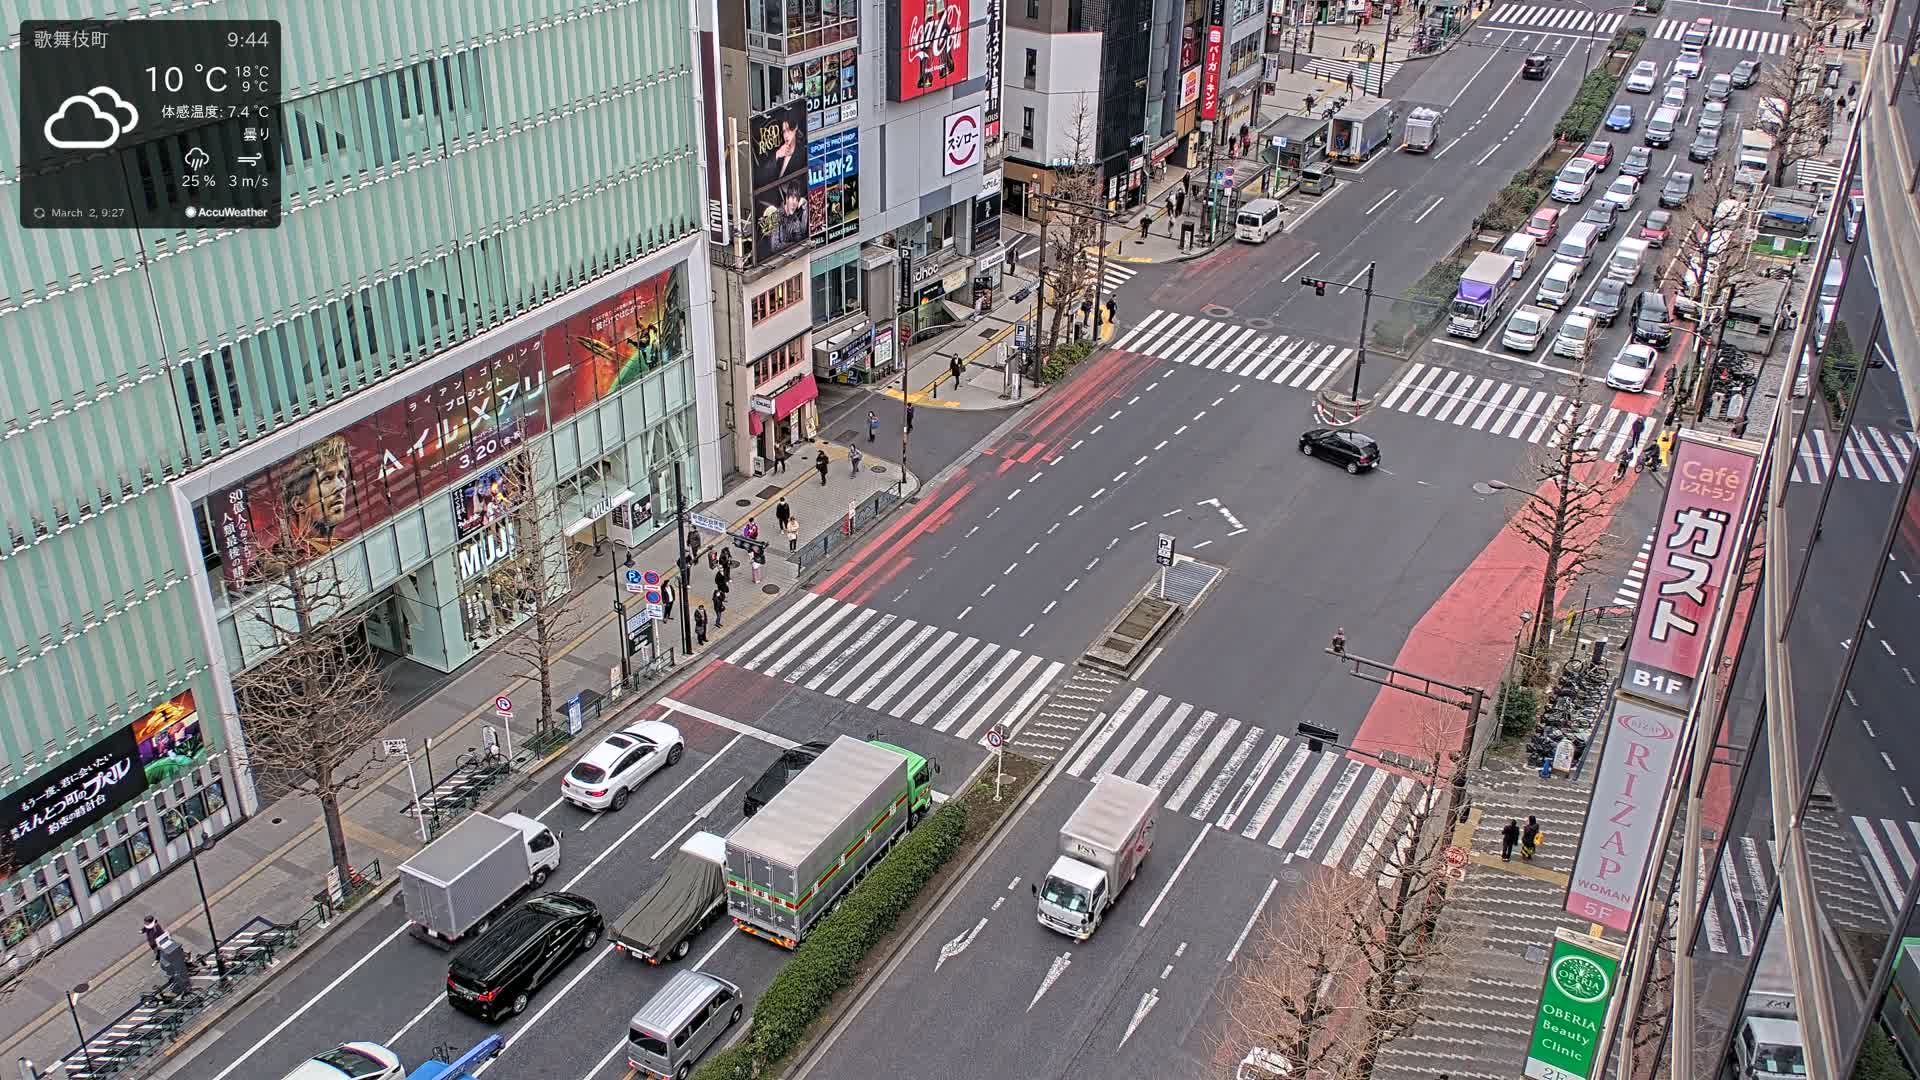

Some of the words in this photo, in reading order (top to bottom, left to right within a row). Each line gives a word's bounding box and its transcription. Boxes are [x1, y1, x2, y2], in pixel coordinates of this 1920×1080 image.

[1205, 45, 1219, 110] バーガーキング
[947, 132, 979, 152] スシロー
[808, 154, 854, 186] ALLERY-2
[709, 199, 722, 232] MUJI
[902, 249, 909, 258] P
[1017, 326, 1025, 335] P
[829, 351, 839, 366] P
[445, 377, 503, 411] プロジェクト
[459, 439, 497, 469] 3.20
[1681, 460, 1741, 489] Café
[1679, 479, 1737, 502] レストラン
[591, 497, 613, 518] MUJI
[459, 521, 516, 580] MUJI
[1160, 539, 1169, 549] P
[628, 572, 637, 584] P
[1652, 507, 1728, 642] ガスト
[1632, 668, 1682, 695] B1F
[1598, 741, 1655, 880] RIZAP
[1578, 880, 1631, 904] WOMAN
[1583, 902, 1613, 919] 5F
[1558, 970, 1600, 991] OBERIA
[1543, 1004, 1596, 1032] OBERIA
[1543, 1019, 1590, 1046] Beauty
[1542, 1038, 1583, 1061] Clinic
